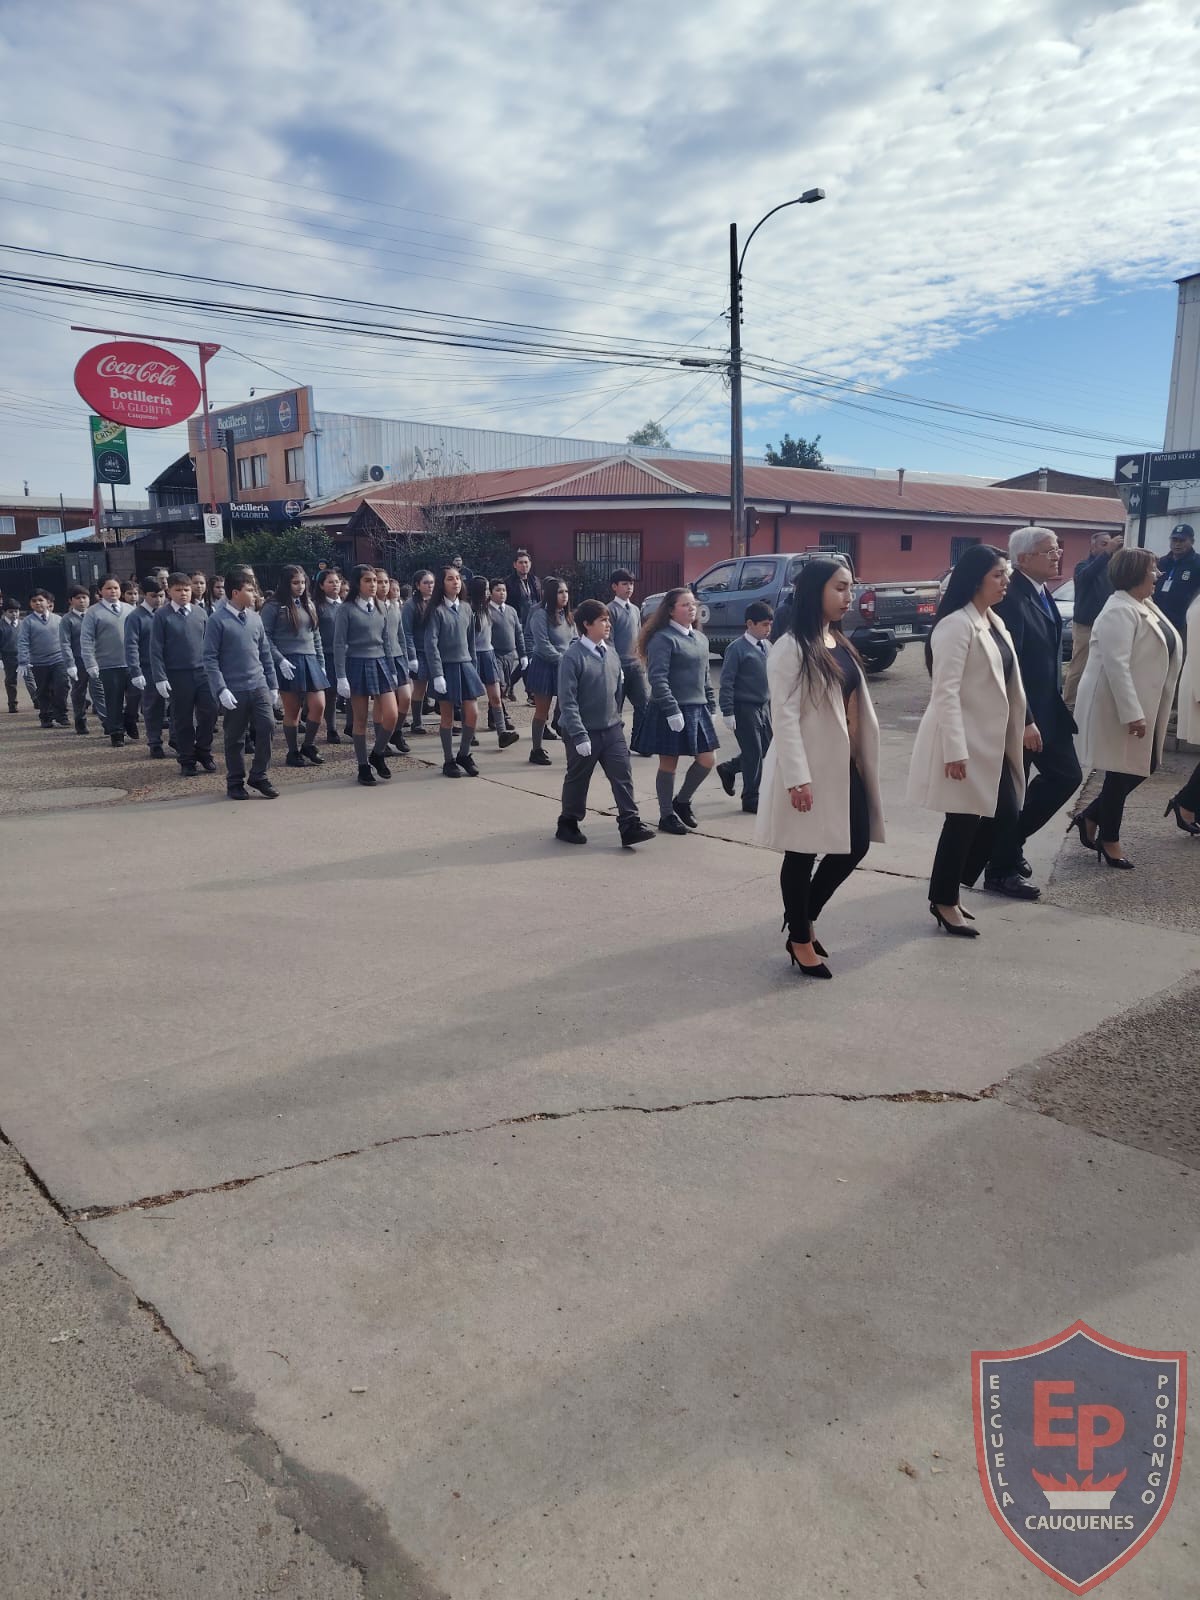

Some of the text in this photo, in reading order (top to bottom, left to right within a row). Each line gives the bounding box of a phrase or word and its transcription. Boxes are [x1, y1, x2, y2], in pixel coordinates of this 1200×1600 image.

[96, 355, 180, 386] Coca-Cola
[109, 387, 173, 406] Botillería
[112, 401, 125, 411] LA
[210, 517, 217, 526] E
